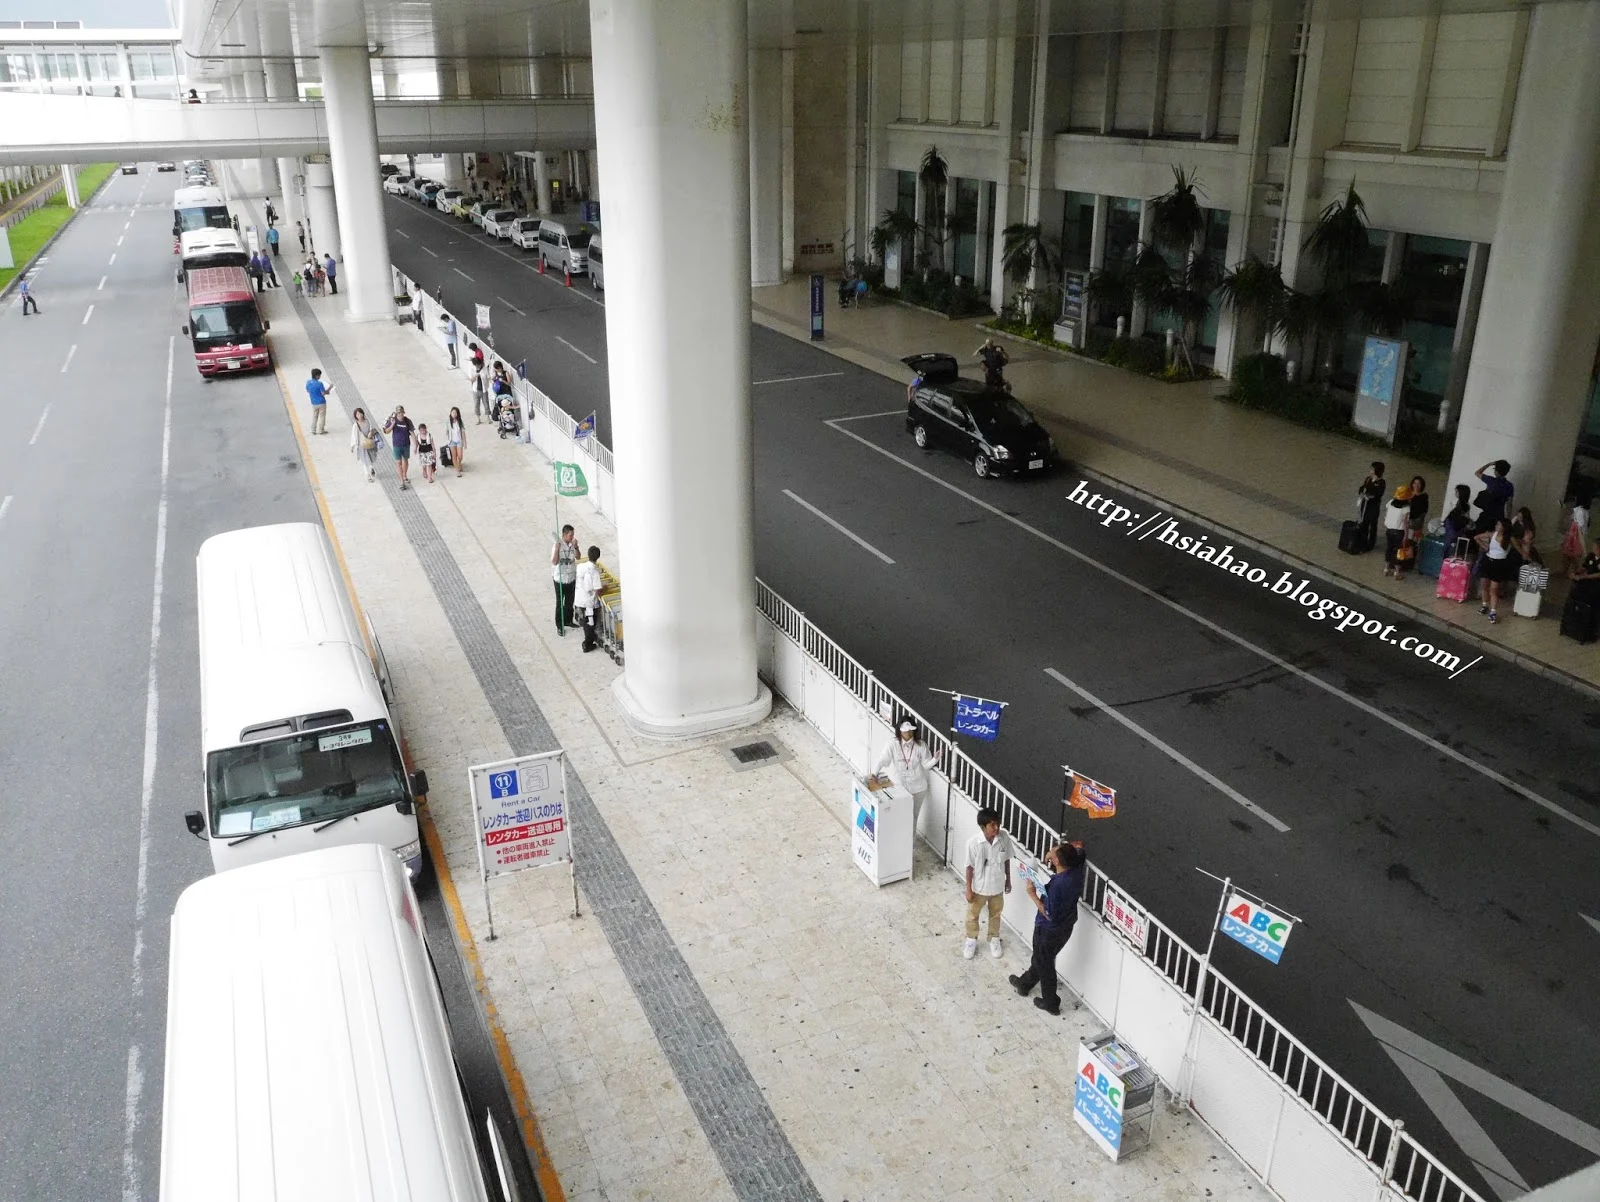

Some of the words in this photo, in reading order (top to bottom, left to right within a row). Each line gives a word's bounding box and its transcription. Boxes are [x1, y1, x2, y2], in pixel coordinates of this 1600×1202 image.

[957, 721, 995, 734] レンタカー
[497, 775, 509, 787] 11
[501, 799, 519, 808] Rent
[488, 820, 561, 843] レンタカー送迎専用
[1106, 896, 1144, 942] 駐車禁止
[1222, 918, 1279, 957] レンタカー
[1229, 903, 1288, 942] ABC
[1078, 1079, 1119, 1124] レンタカー
[1081, 1062, 1121, 1109] ABC
